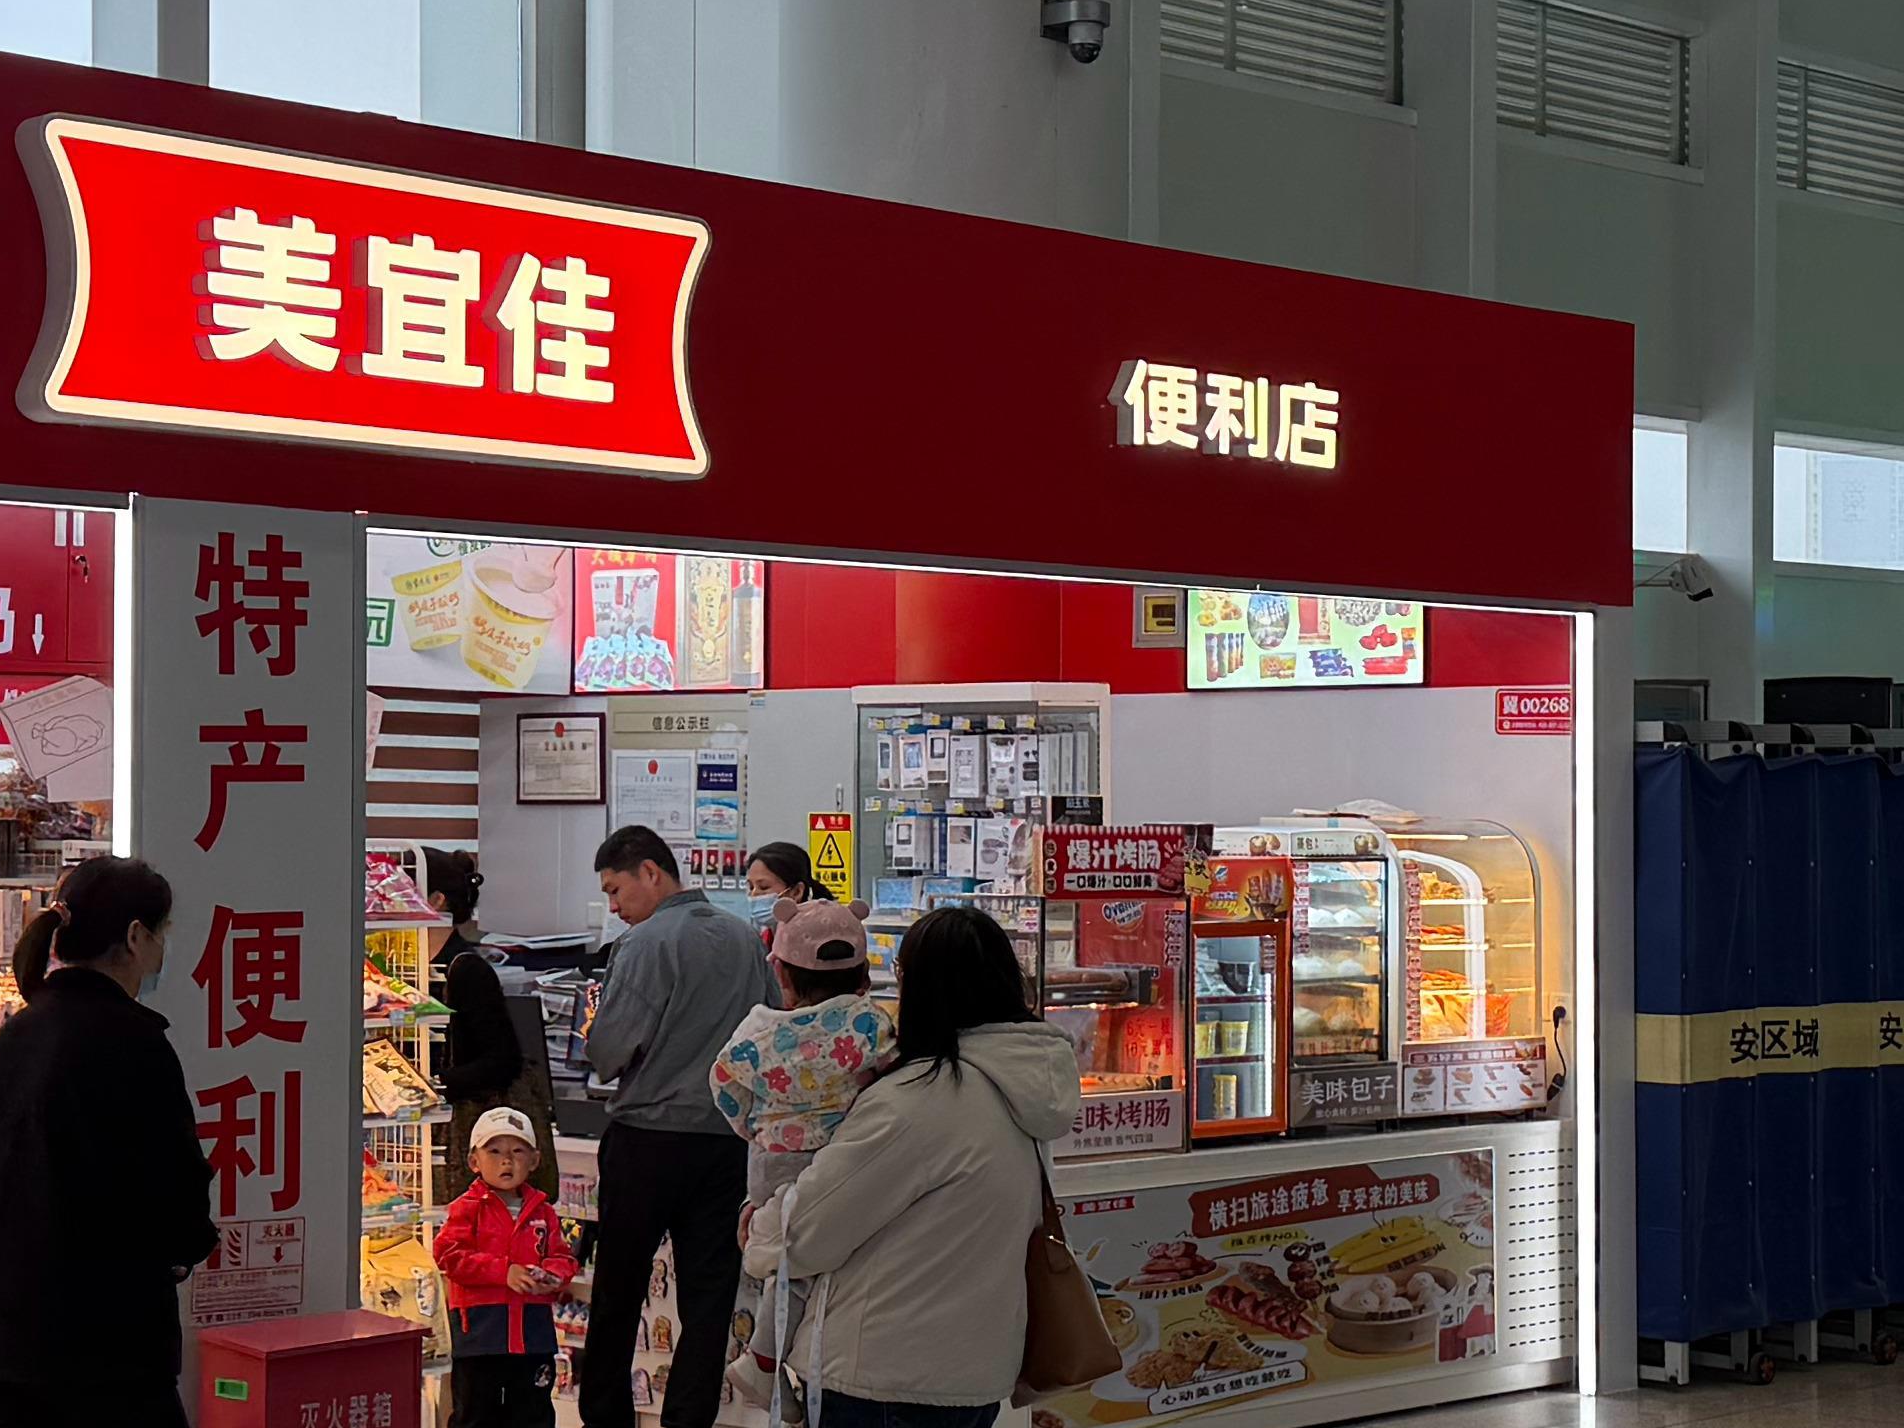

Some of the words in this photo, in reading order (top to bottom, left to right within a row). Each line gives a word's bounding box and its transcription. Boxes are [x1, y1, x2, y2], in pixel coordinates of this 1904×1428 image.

[205, 206, 615, 404] 美宜佳
[1122, 358, 1340, 470] 便利店
[652, 715, 710, 730] 信息公示栏
[1520, 697, 1570, 714] 00268
[192, 531, 310, 1218] 特产便利
[1066, 838, 1162, 871] 爆汁烤肠
[1301, 1075, 1395, 1106] 美味包子
[1208, 1177, 1330, 1231] 横扫旅途疲惫
[1337, 1180, 1429, 1213] 享受家的美味
